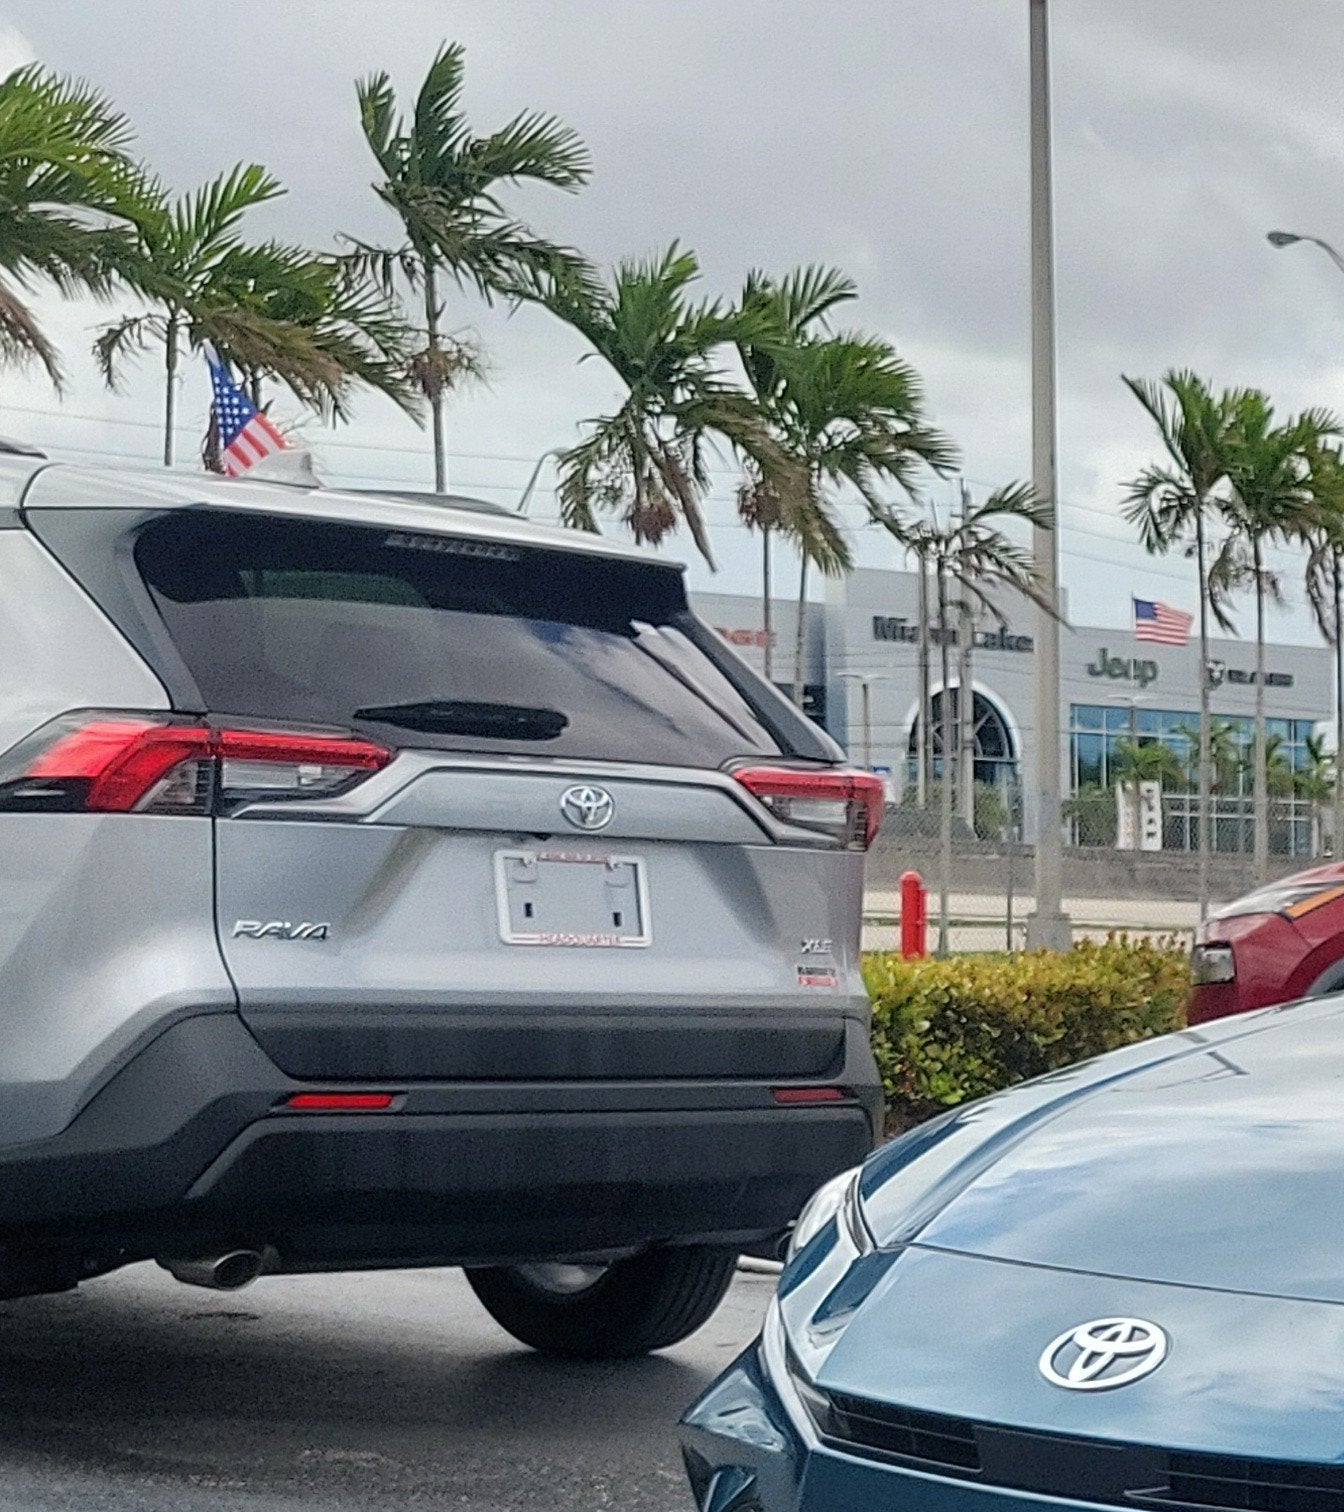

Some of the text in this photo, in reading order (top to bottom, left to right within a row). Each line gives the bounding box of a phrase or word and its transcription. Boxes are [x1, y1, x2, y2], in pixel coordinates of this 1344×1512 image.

[972, 625, 1034, 652] Lake
[1086, 647, 1158, 689] Jeep
[232, 920, 331, 941] RAV4
